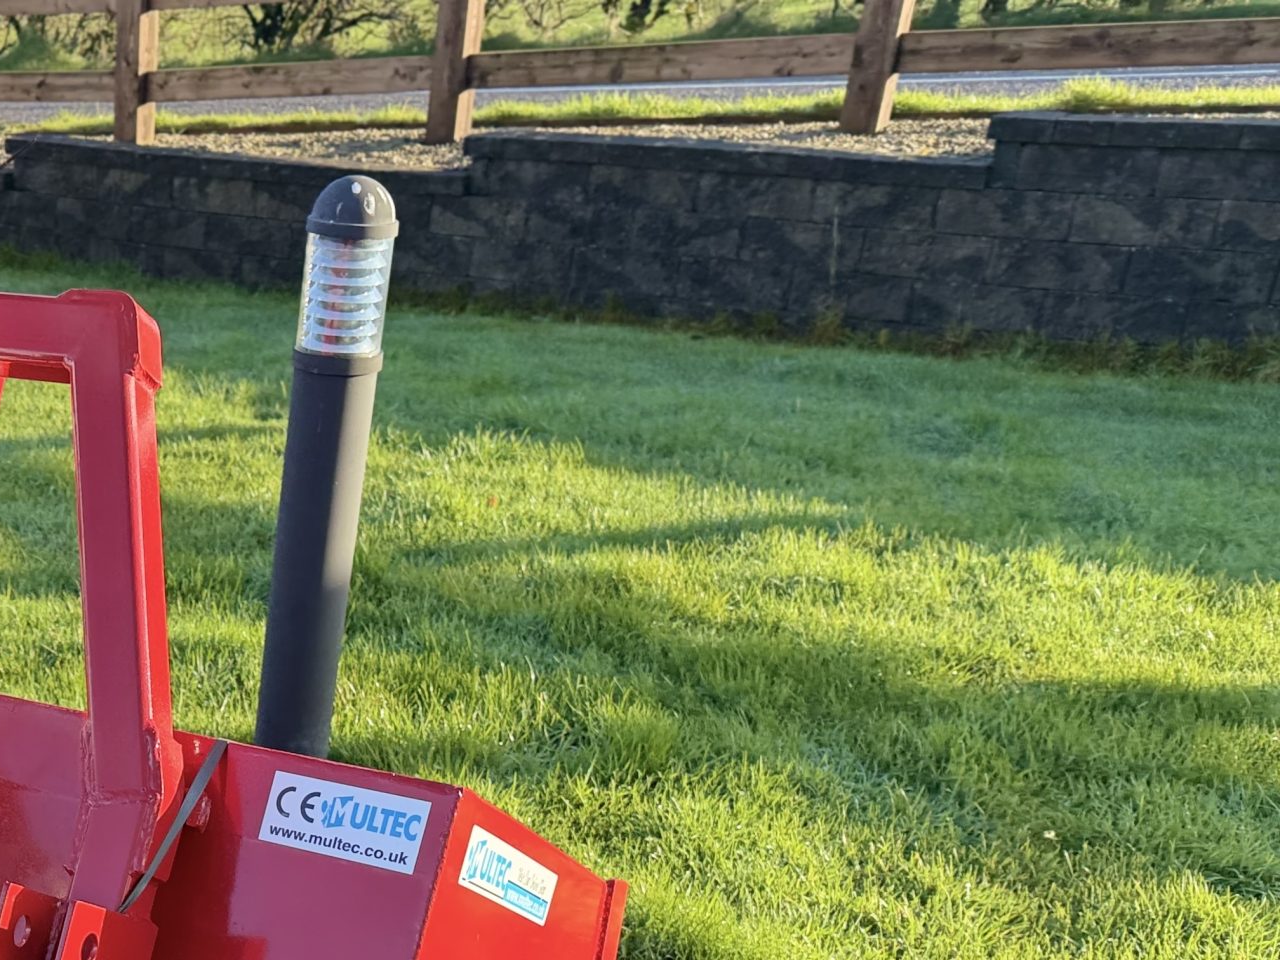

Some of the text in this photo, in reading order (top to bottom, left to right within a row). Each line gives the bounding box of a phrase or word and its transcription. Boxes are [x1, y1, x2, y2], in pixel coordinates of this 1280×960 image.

[276, 786, 422, 842] CE MULTEC
[269, 824, 409, 866] www.multec.co.uk
